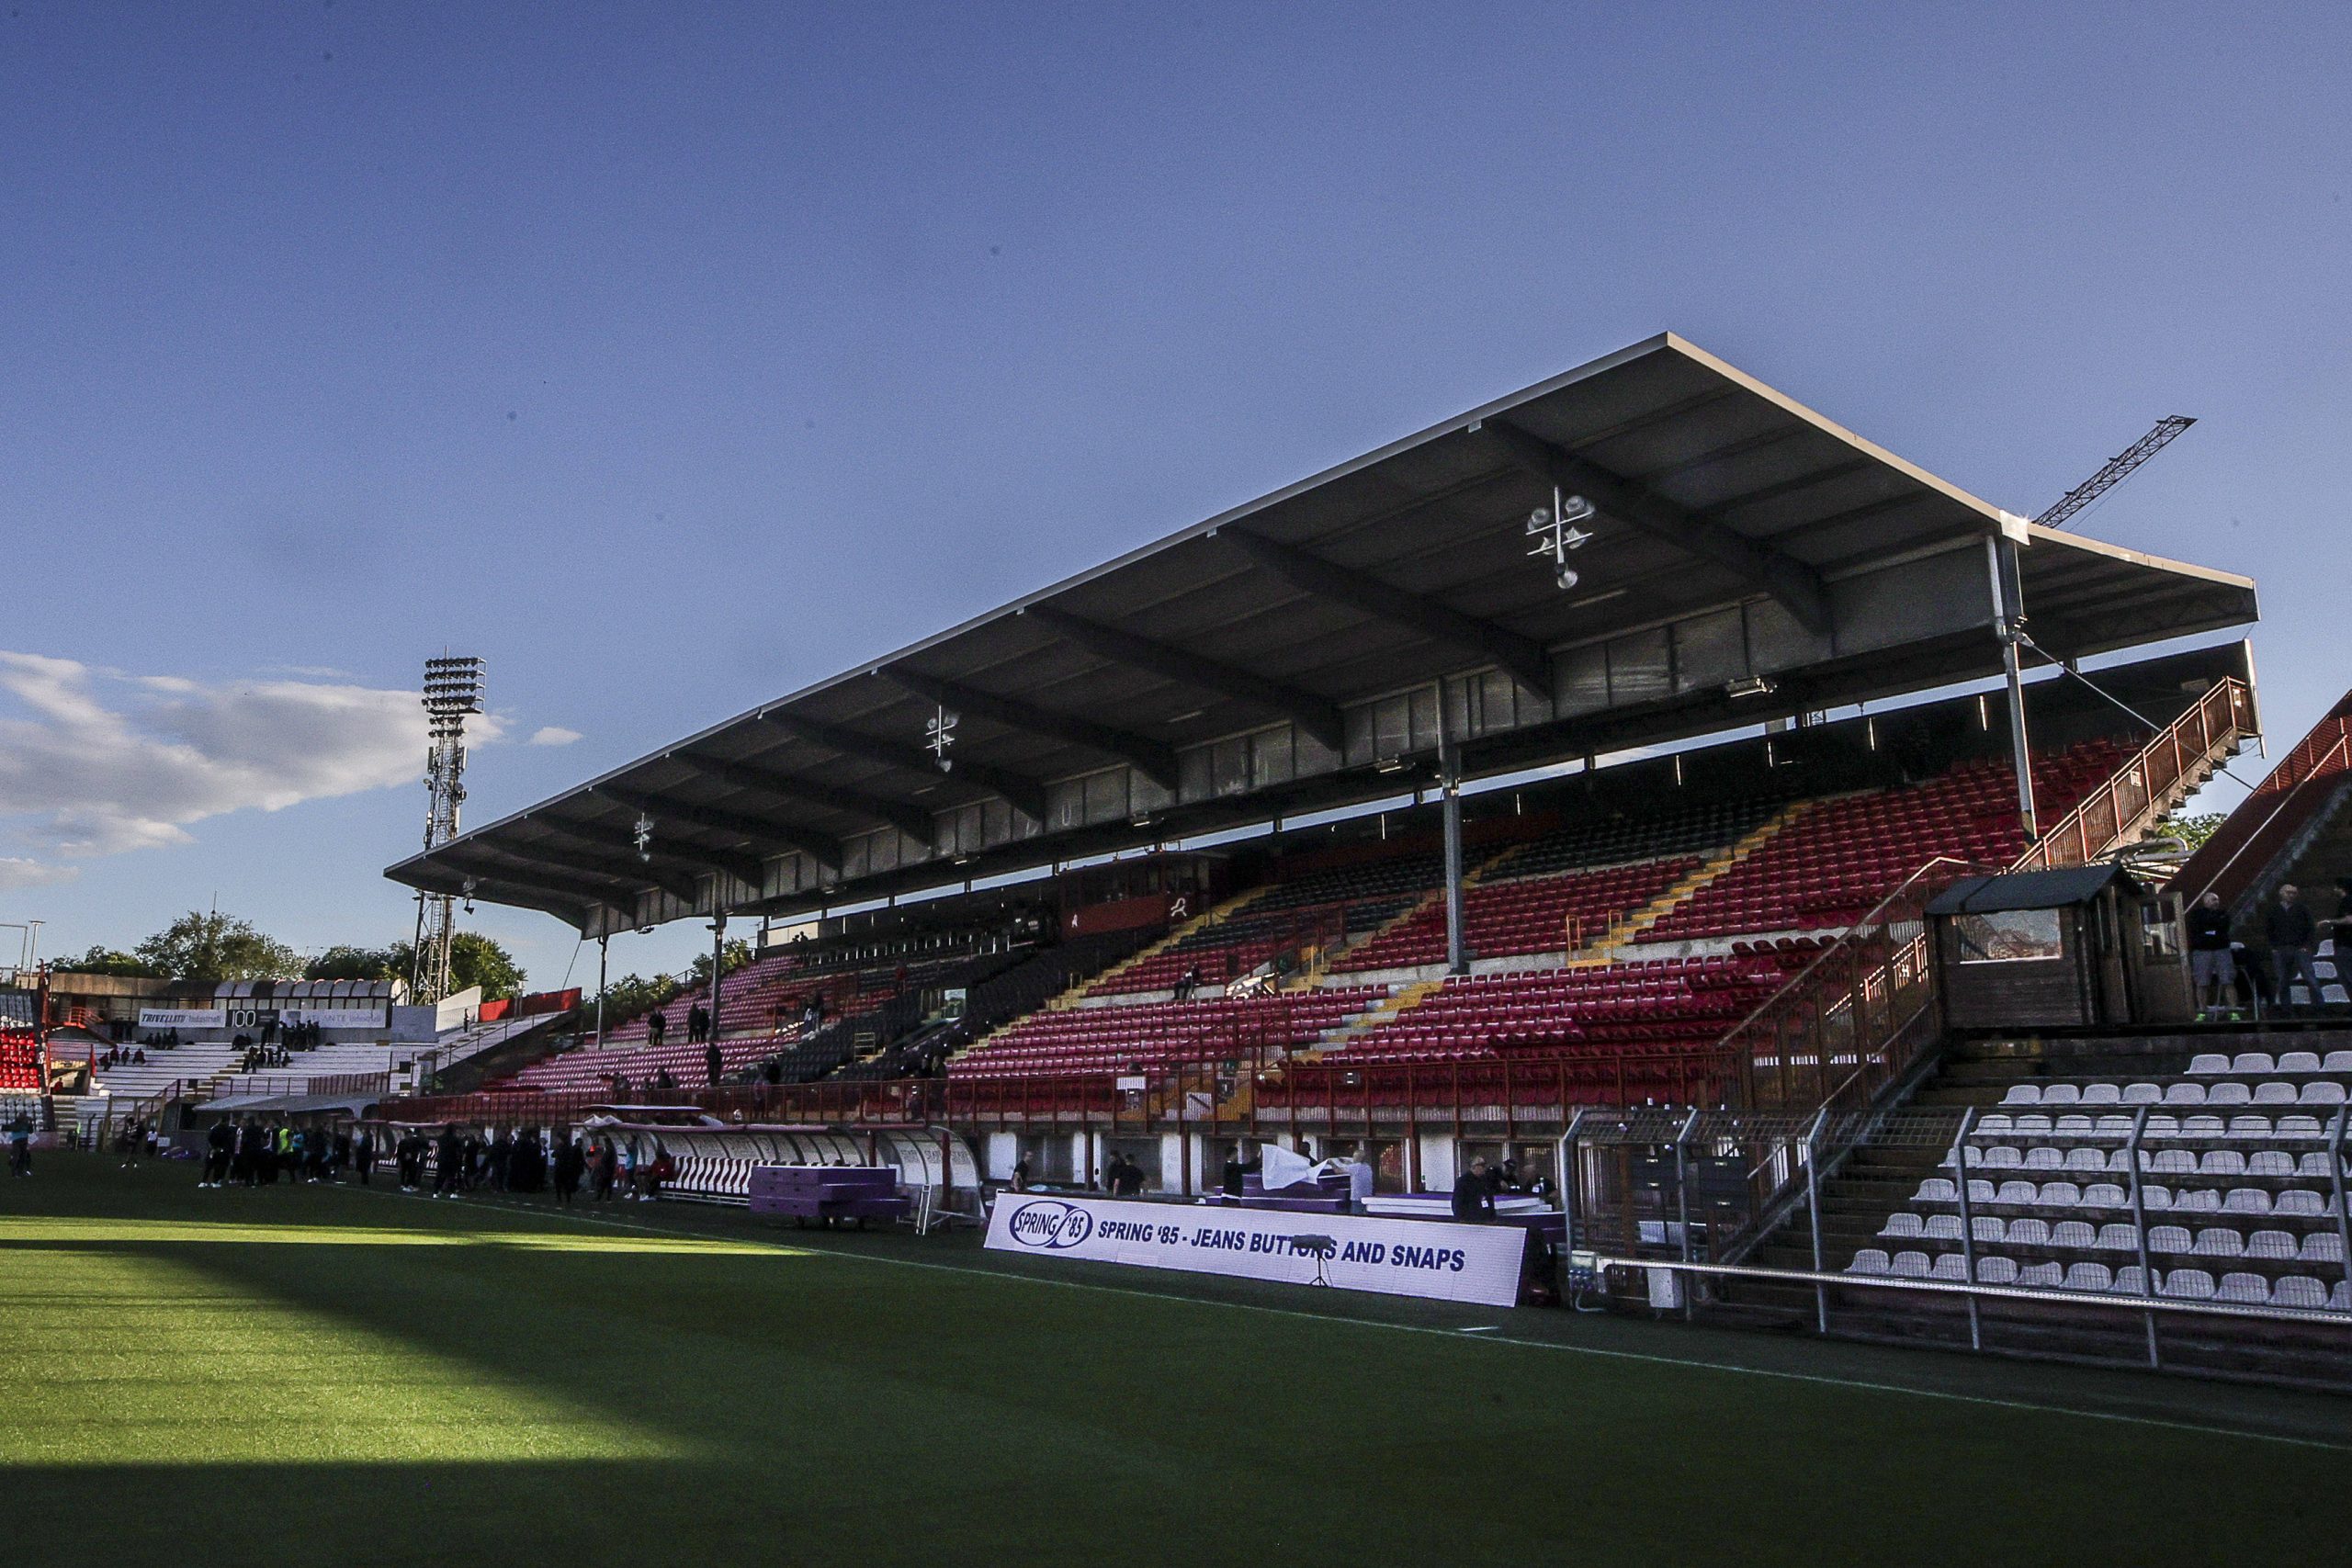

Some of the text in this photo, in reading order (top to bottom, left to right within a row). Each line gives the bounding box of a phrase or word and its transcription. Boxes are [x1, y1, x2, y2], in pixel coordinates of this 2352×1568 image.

[232, 1010, 256, 1027] 100
[1014, 1212, 1059, 1236] SPRING
[1098, 1221, 1153, 1241] SPRING
[1191, 1228, 1245, 1251] JEANS
[1341, 1241, 1385, 1264] AND
[1391, 1245, 1465, 1272] SNAPS
